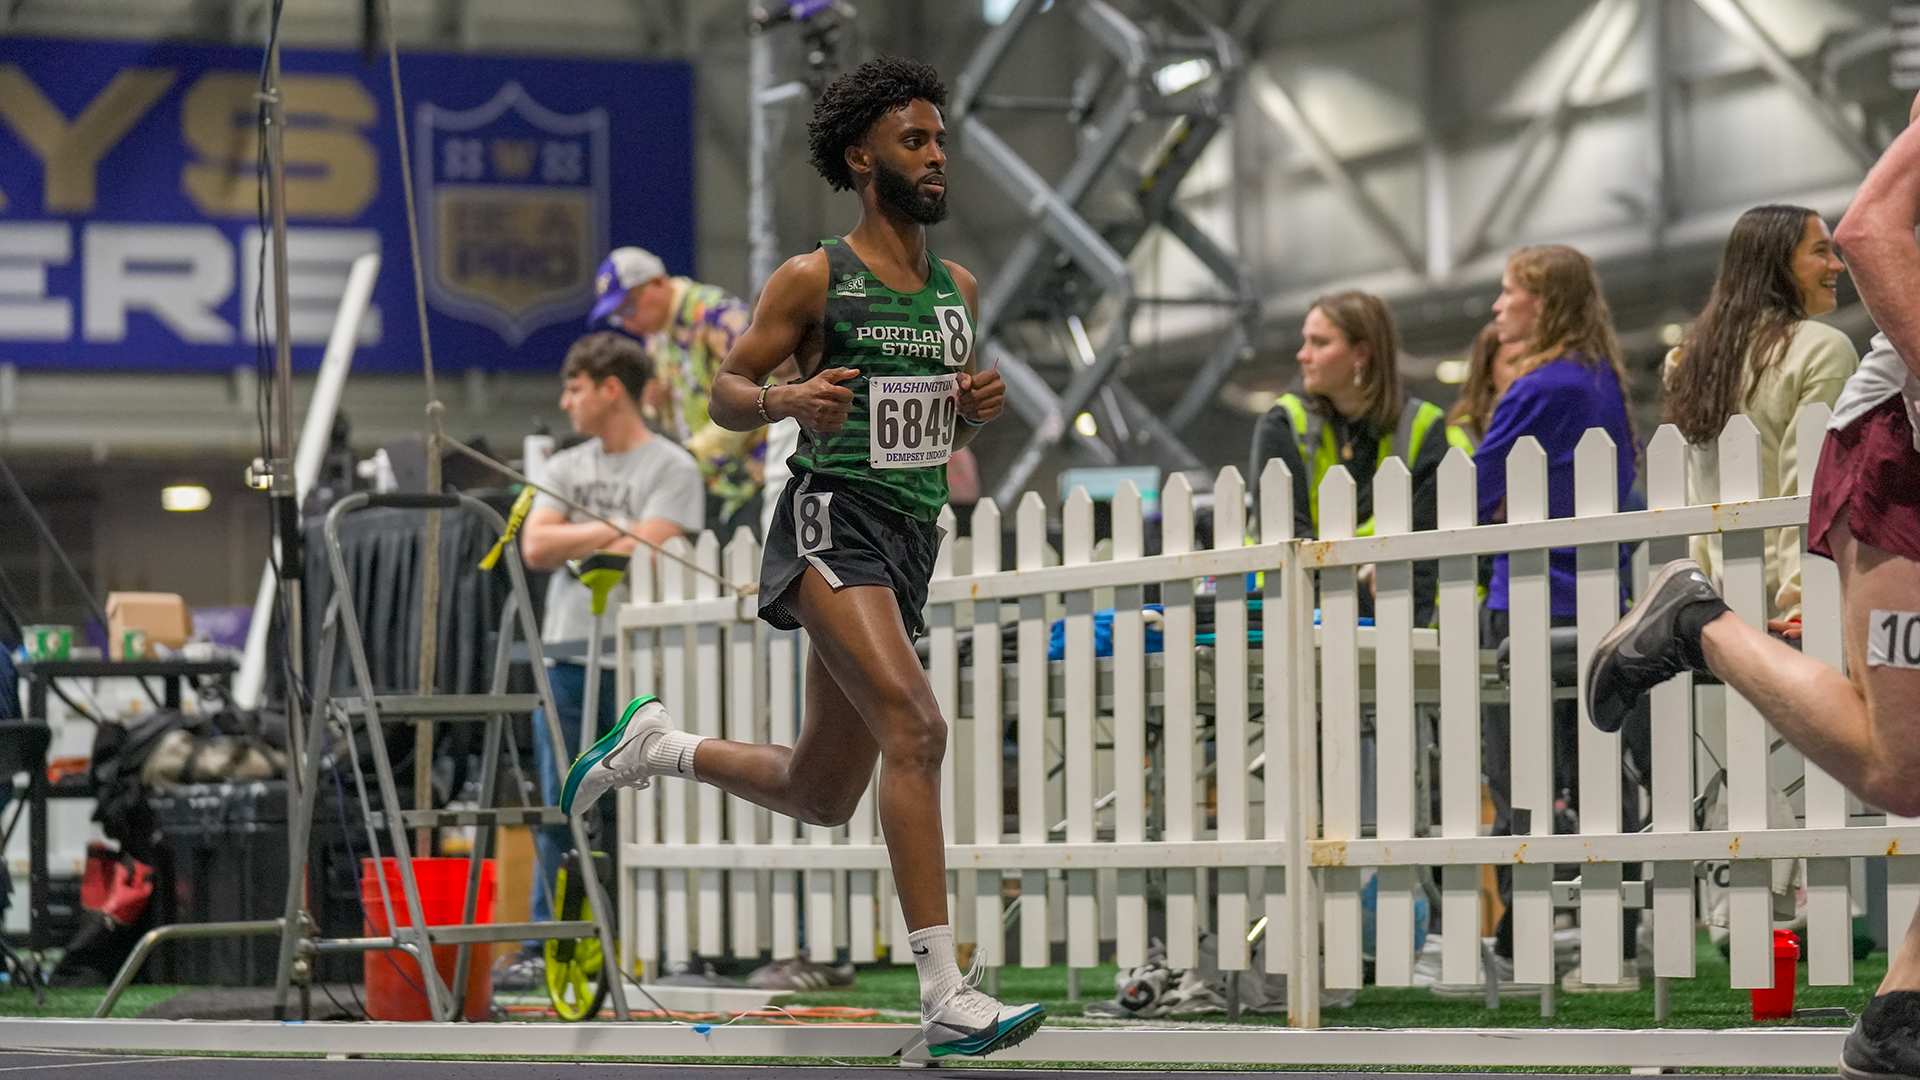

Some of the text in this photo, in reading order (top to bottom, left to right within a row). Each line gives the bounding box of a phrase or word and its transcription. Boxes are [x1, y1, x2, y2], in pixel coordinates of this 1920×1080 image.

[0, 64, 378, 217] YS
[856, 325, 945, 344] PORTLAN
[881, 341, 942, 360] STATE
[943, 308, 968, 363] 8
[882, 379, 954, 394] WASHINGTON
[876, 395, 956, 450] 6849
[885, 451, 925, 463] DEMPSEY
[926, 449, 947, 460] INDOOR
[800, 495, 823, 551] 8
[1881, 613, 1920, 665] 10
